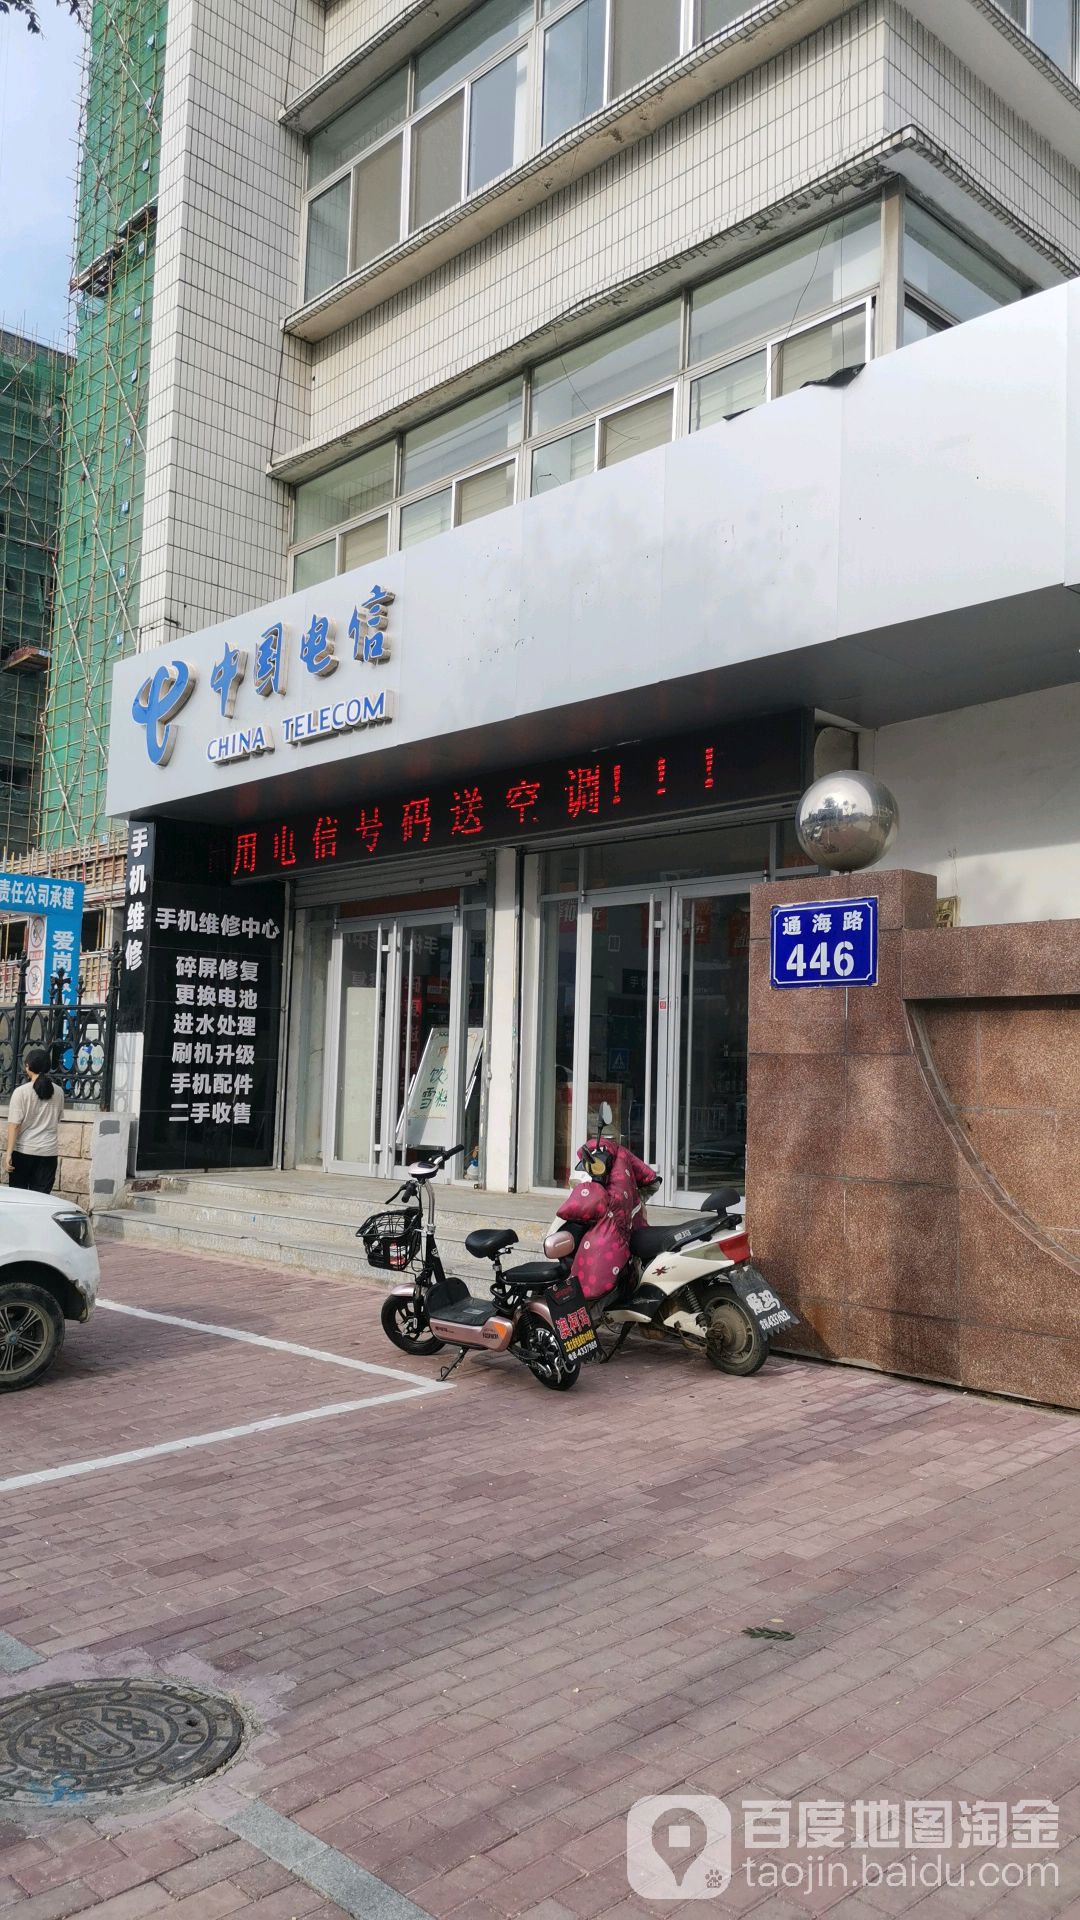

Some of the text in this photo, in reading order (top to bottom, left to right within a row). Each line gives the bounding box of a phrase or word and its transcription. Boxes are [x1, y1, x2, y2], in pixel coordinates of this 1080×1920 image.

[211, 584, 395, 718] 中国电信
[206, 692, 388, 763] CHINA TELECOM
[125, 826, 149, 972] 手机维修
[155, 907, 280, 940] 手机维修中心
[782, 909, 863, 936] 通海路
[175, 956, 260, 982] 碎屏修复
[786, 940, 854, 977] 446
[174, 983, 258, 1010] 更换电池
[173, 1014, 257, 1037] 进水处理
[171, 1041, 255, 1066] 刷机升级
[170, 1072, 253, 1095] 手机配件
[168, 1102, 251, 1125] 二手收售
